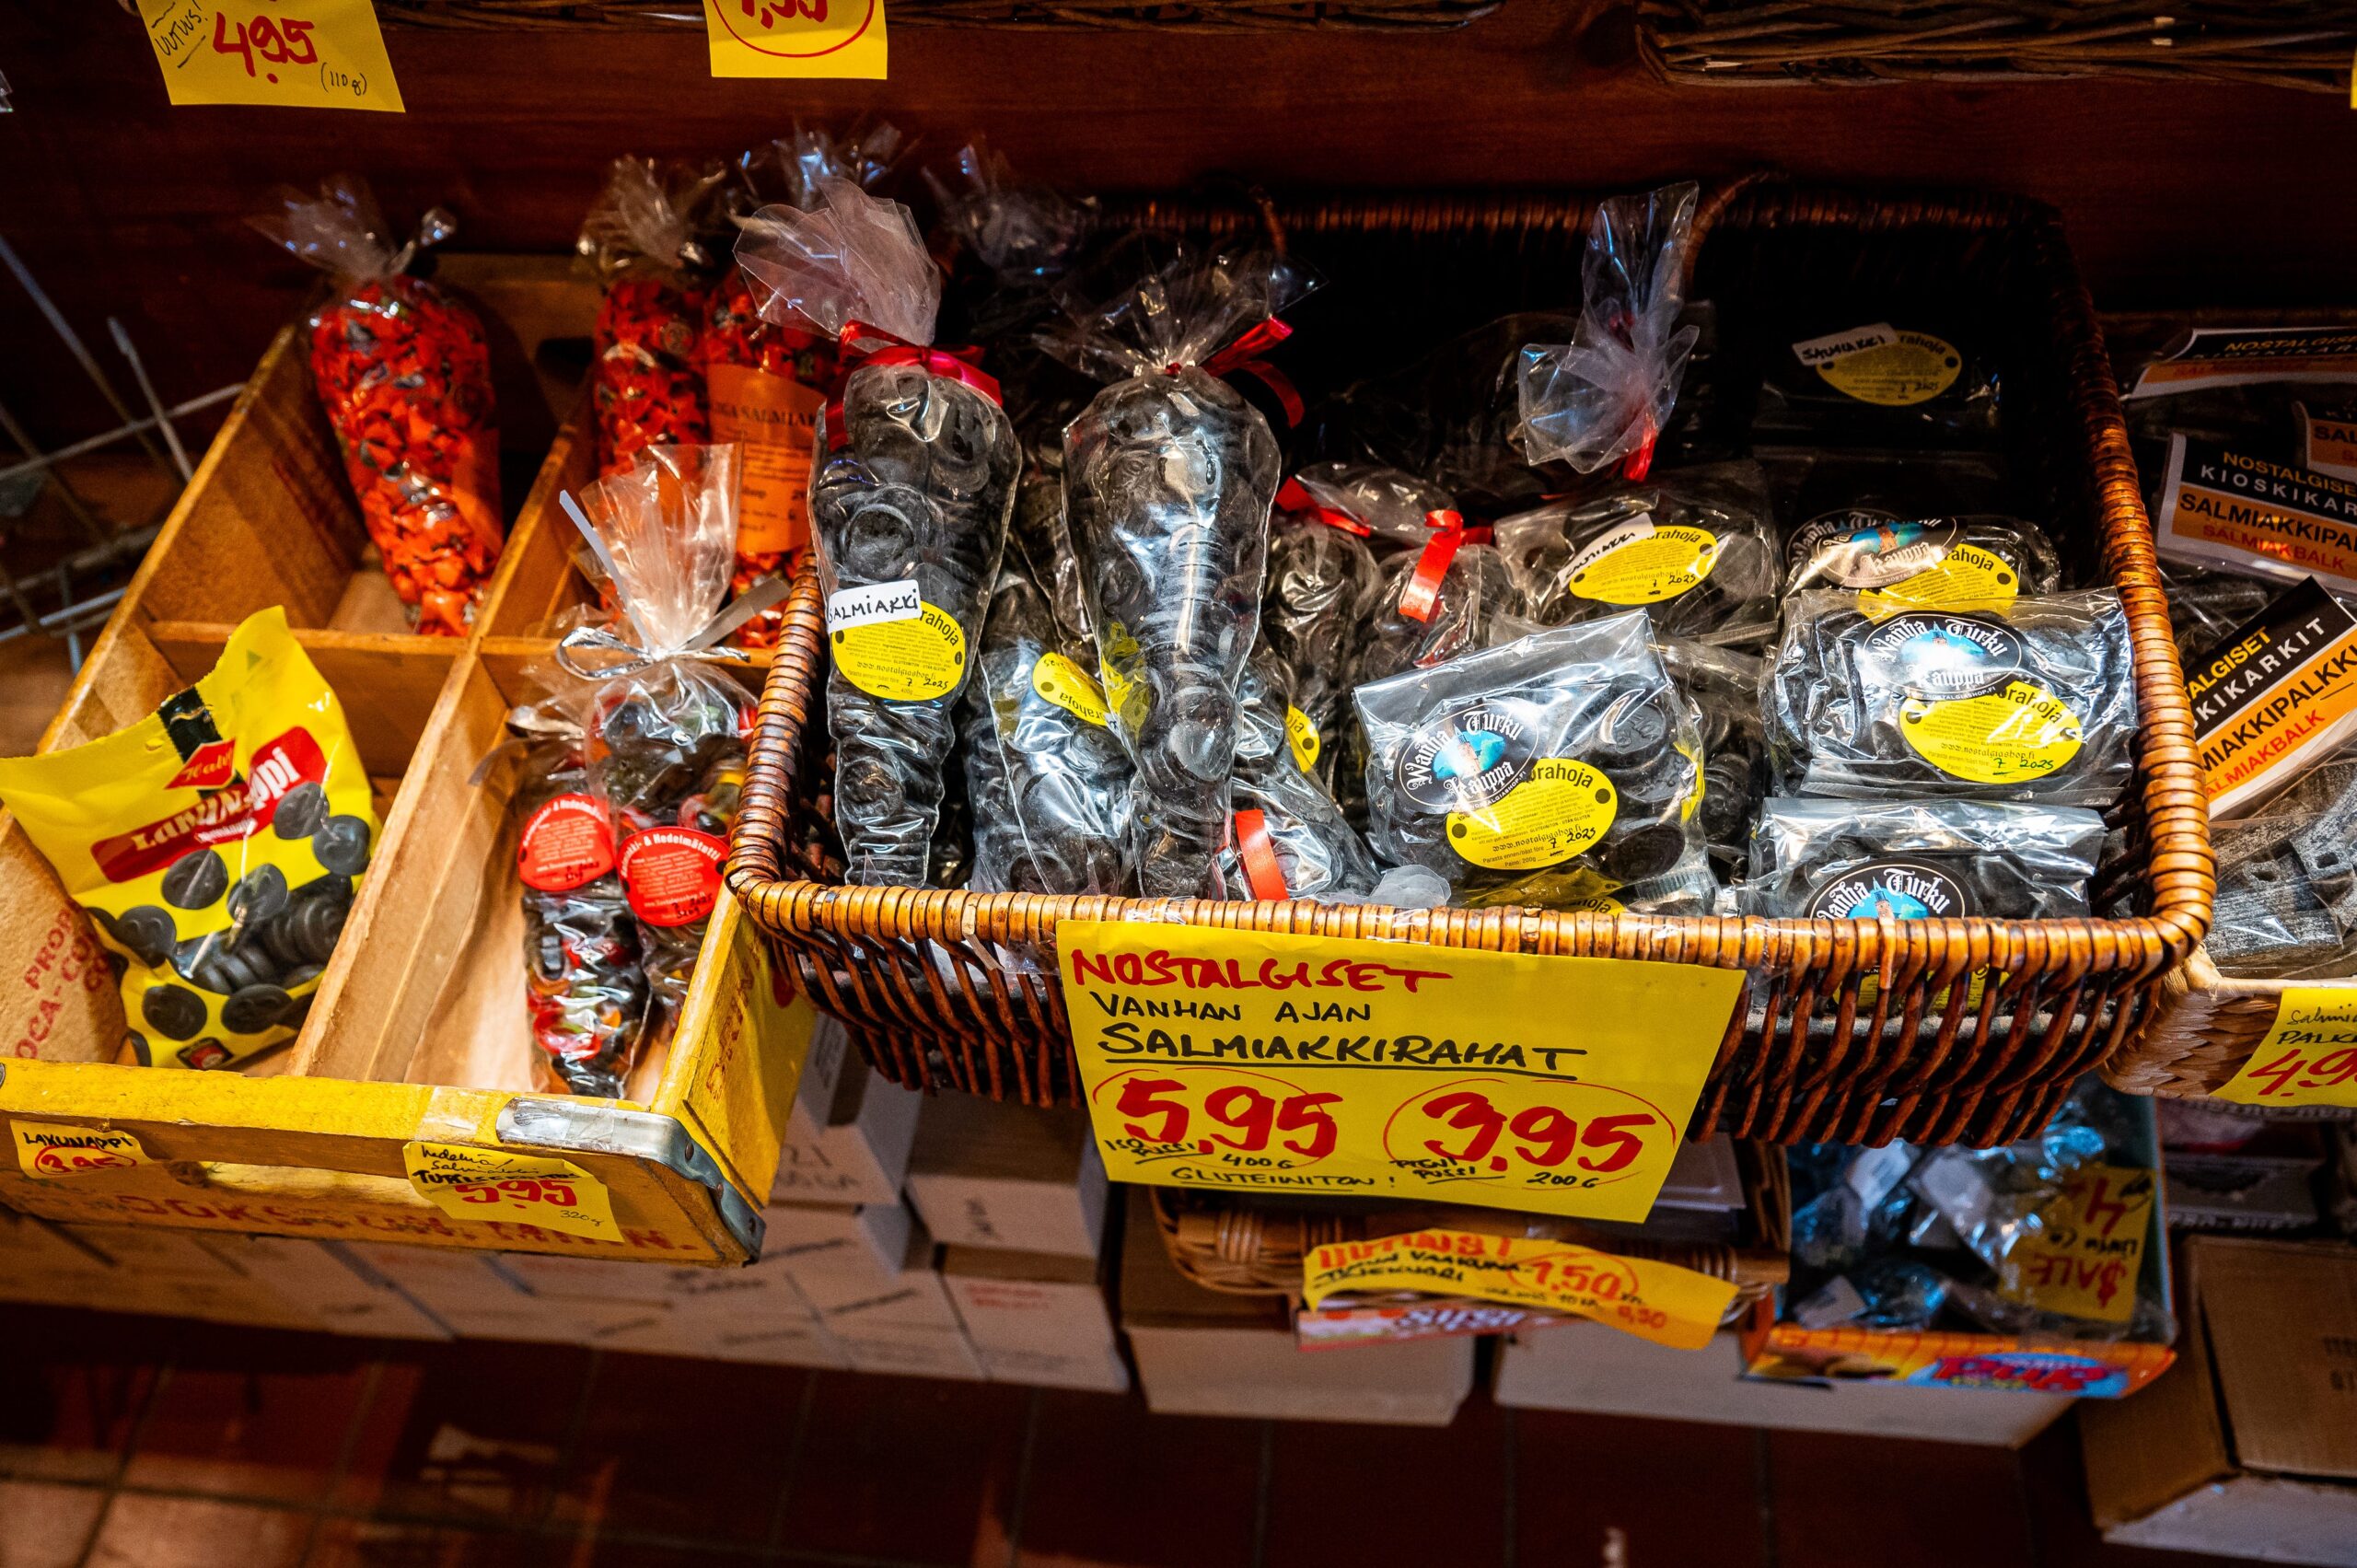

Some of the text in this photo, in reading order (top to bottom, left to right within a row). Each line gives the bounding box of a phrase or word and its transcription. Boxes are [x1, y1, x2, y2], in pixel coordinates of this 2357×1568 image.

[2202, 524, 2346, 573] SALMIAKBALK
[919, 610, 959, 646] rahoja
[1945, 618, 2008, 657] Turku
[923, 679, 949, 690] 2025
[1906, 664, 1985, 691] Kauppa
[1462, 708, 1525, 741] Turku
[1444, 760, 1515, 799] Kauppa
[2019, 759, 2054, 770] 2025
[643, 835, 653, 847] &
[1547, 826, 1597, 849] 7 2025
[1482, 854, 1504, 864] Parasta
[1883, 867, 1952, 914] Turku
[1071, 948, 1454, 993] NOSTALGISET
[1089, 990, 1371, 1024] VANHAN AJAN
[1097, 1021, 1588, 1071] SALMIAKKIRAHAT
[1104, 1138, 1144, 1151] ISO
